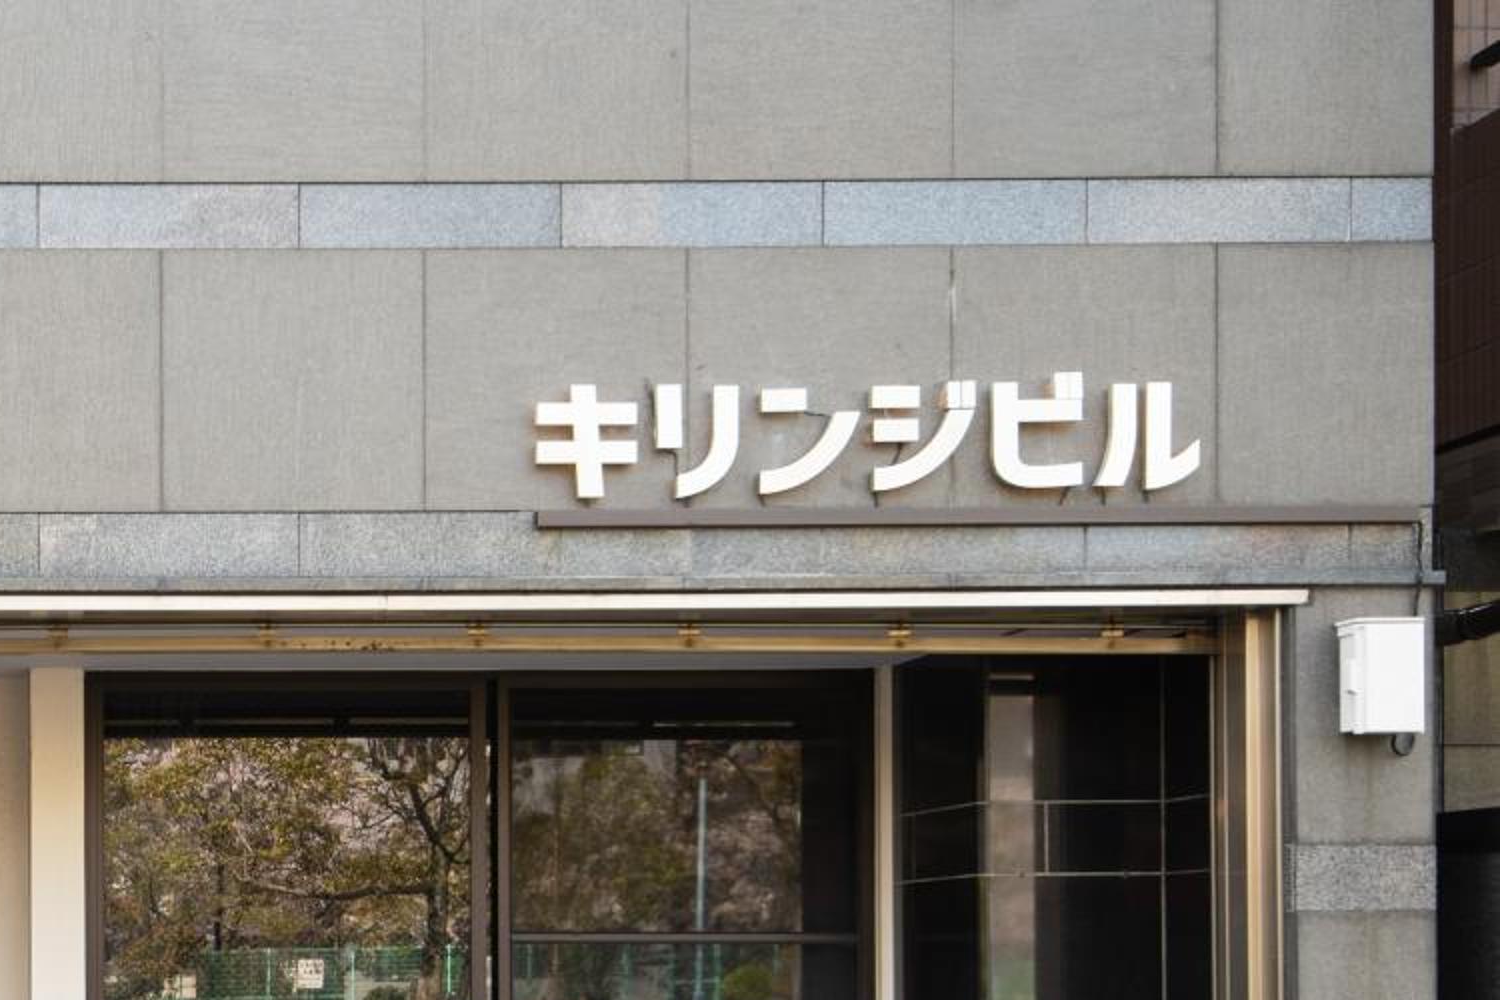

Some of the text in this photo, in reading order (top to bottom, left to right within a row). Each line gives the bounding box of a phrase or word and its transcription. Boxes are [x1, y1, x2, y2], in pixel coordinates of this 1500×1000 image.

[534, 371, 1201, 498] キリンジビル
